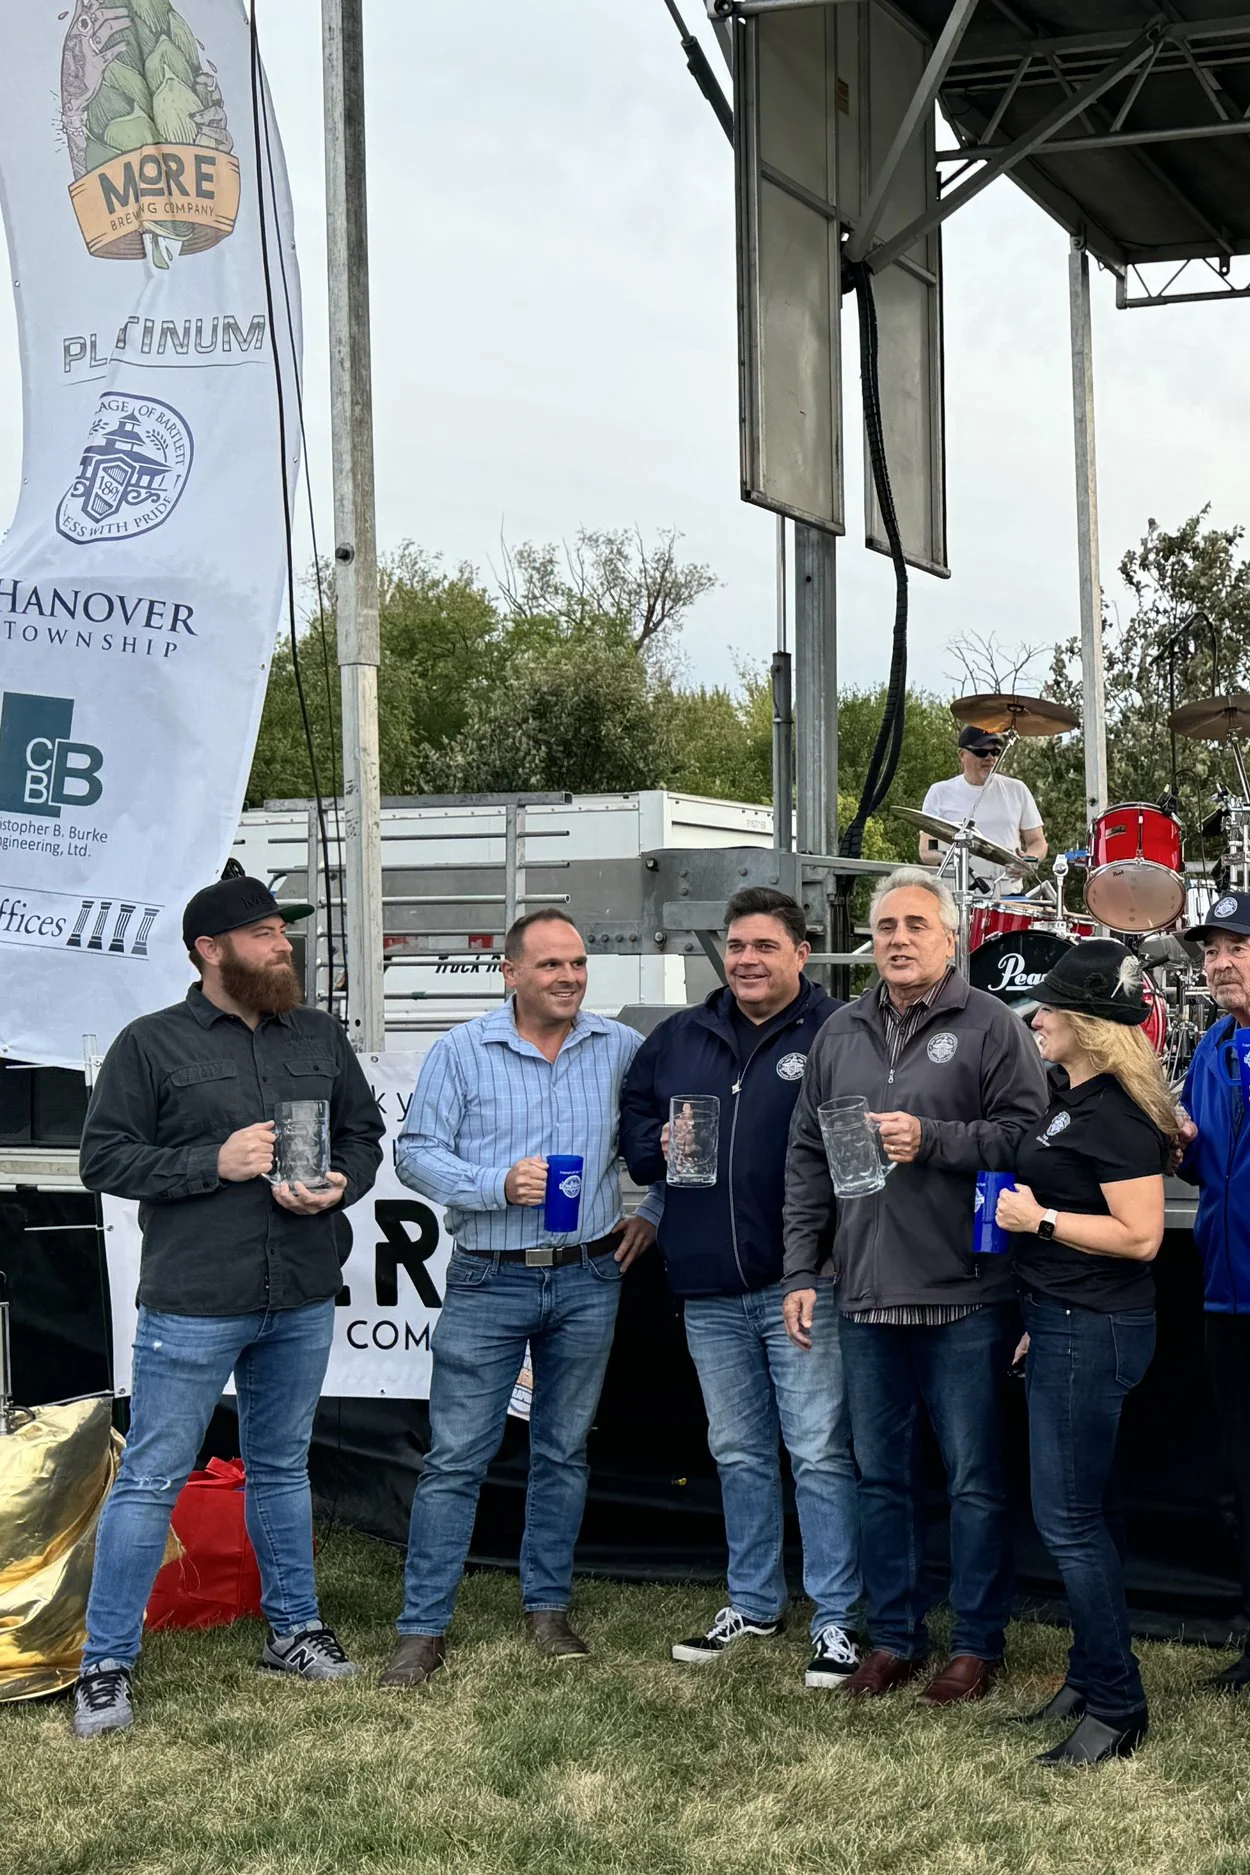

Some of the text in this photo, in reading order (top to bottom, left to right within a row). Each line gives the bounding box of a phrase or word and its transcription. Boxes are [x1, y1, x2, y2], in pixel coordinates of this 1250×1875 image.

[98, 152, 217, 215] MORE
[164, 202, 216, 217] COMPANY
[63, 315, 266, 373] PLTINUM
[138, 404, 157, 419] OF
[155, 412, 186, 466] BARTLETT
[133, 495, 173, 528] PRIDE
[0, 578, 199, 637] HANOVER
[3, 620, 178, 658] TOWNSHIP
[53, 824, 65, 838] B.
[69, 826, 108, 843] Burke
[67, 843, 92, 857] Ltd.
